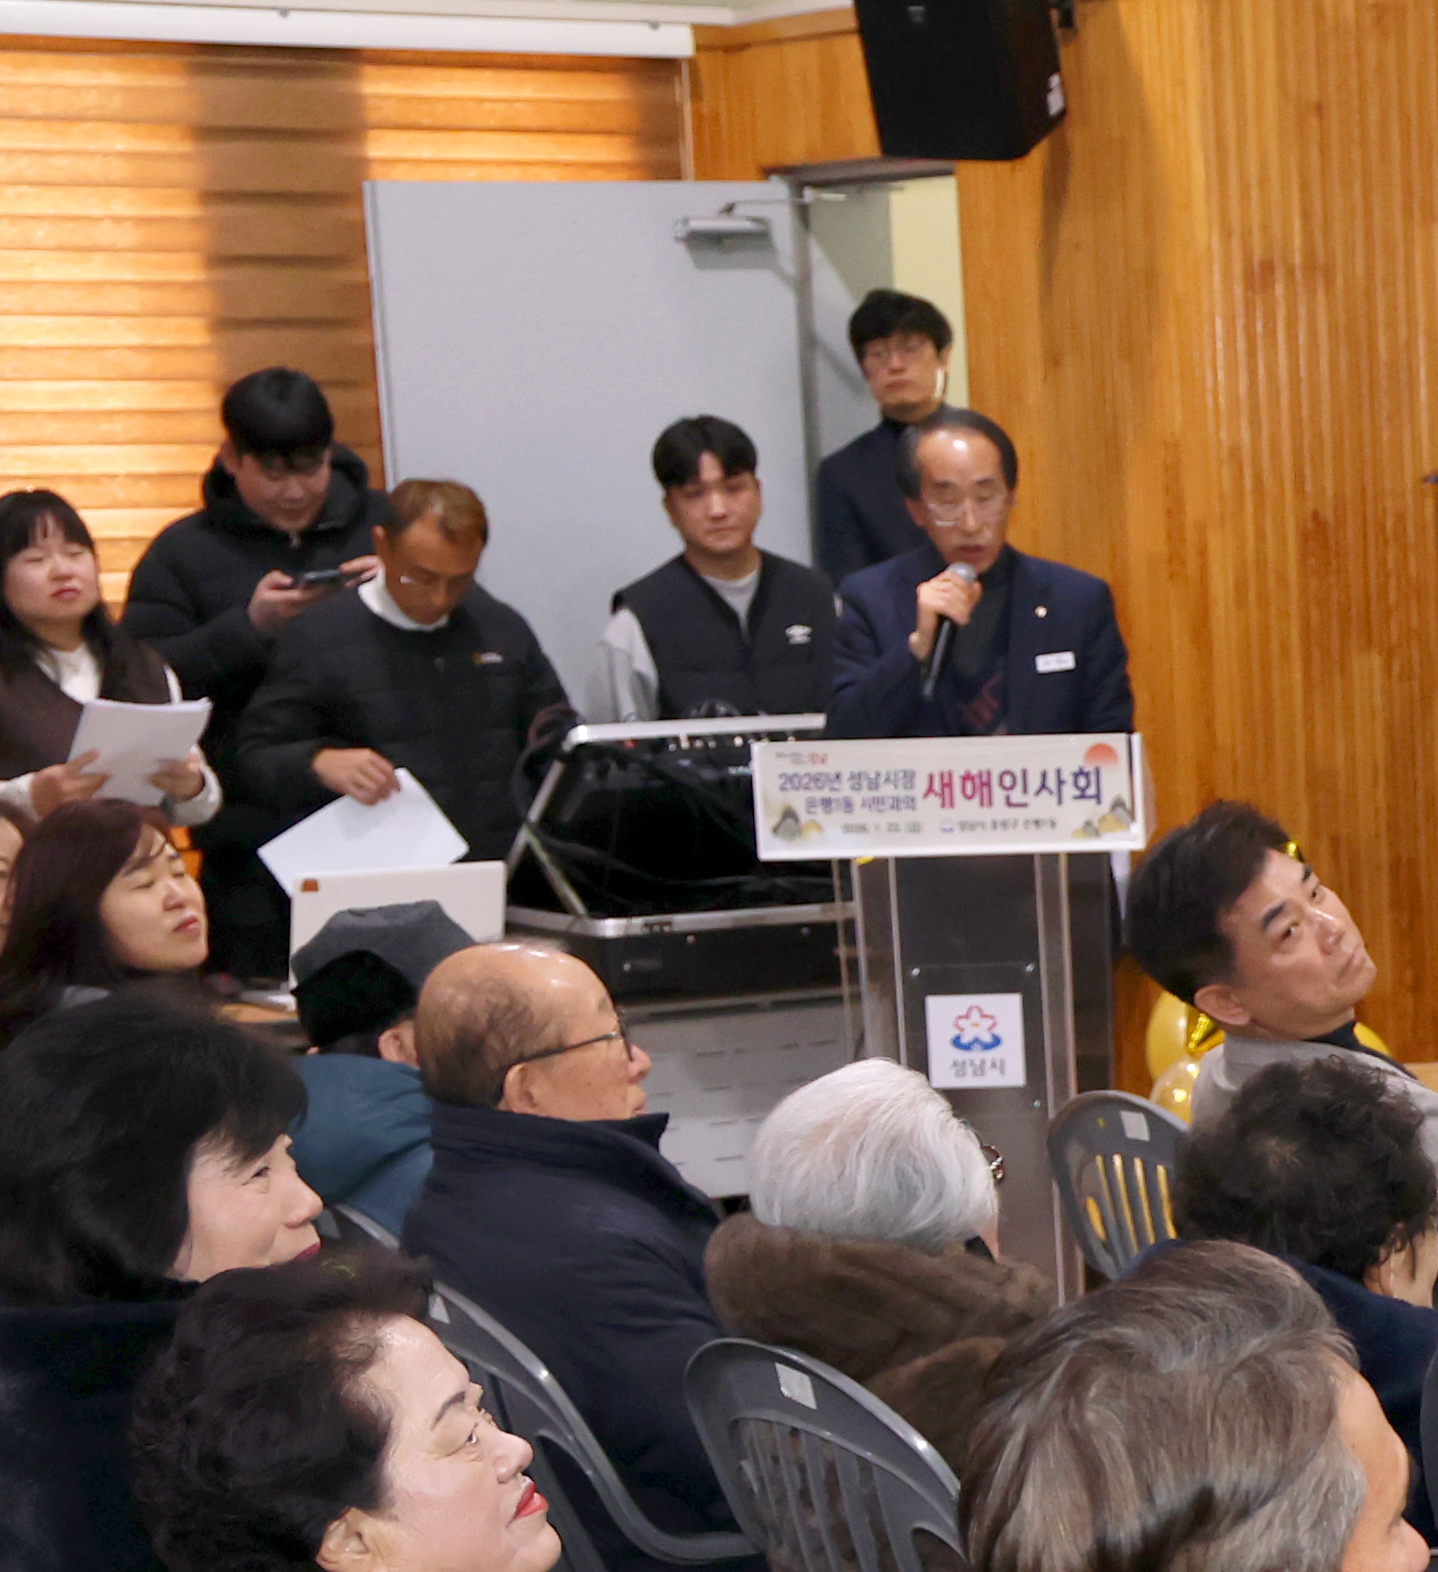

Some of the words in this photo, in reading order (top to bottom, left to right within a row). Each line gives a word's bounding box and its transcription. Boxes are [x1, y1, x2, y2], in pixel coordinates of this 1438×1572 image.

[778, 771, 842, 792] 2026년
[846, 769, 917, 792] 성남시장
[921, 765, 1102, 809] 새해인사회
[951, 1057, 1006, 1078] 성남시
